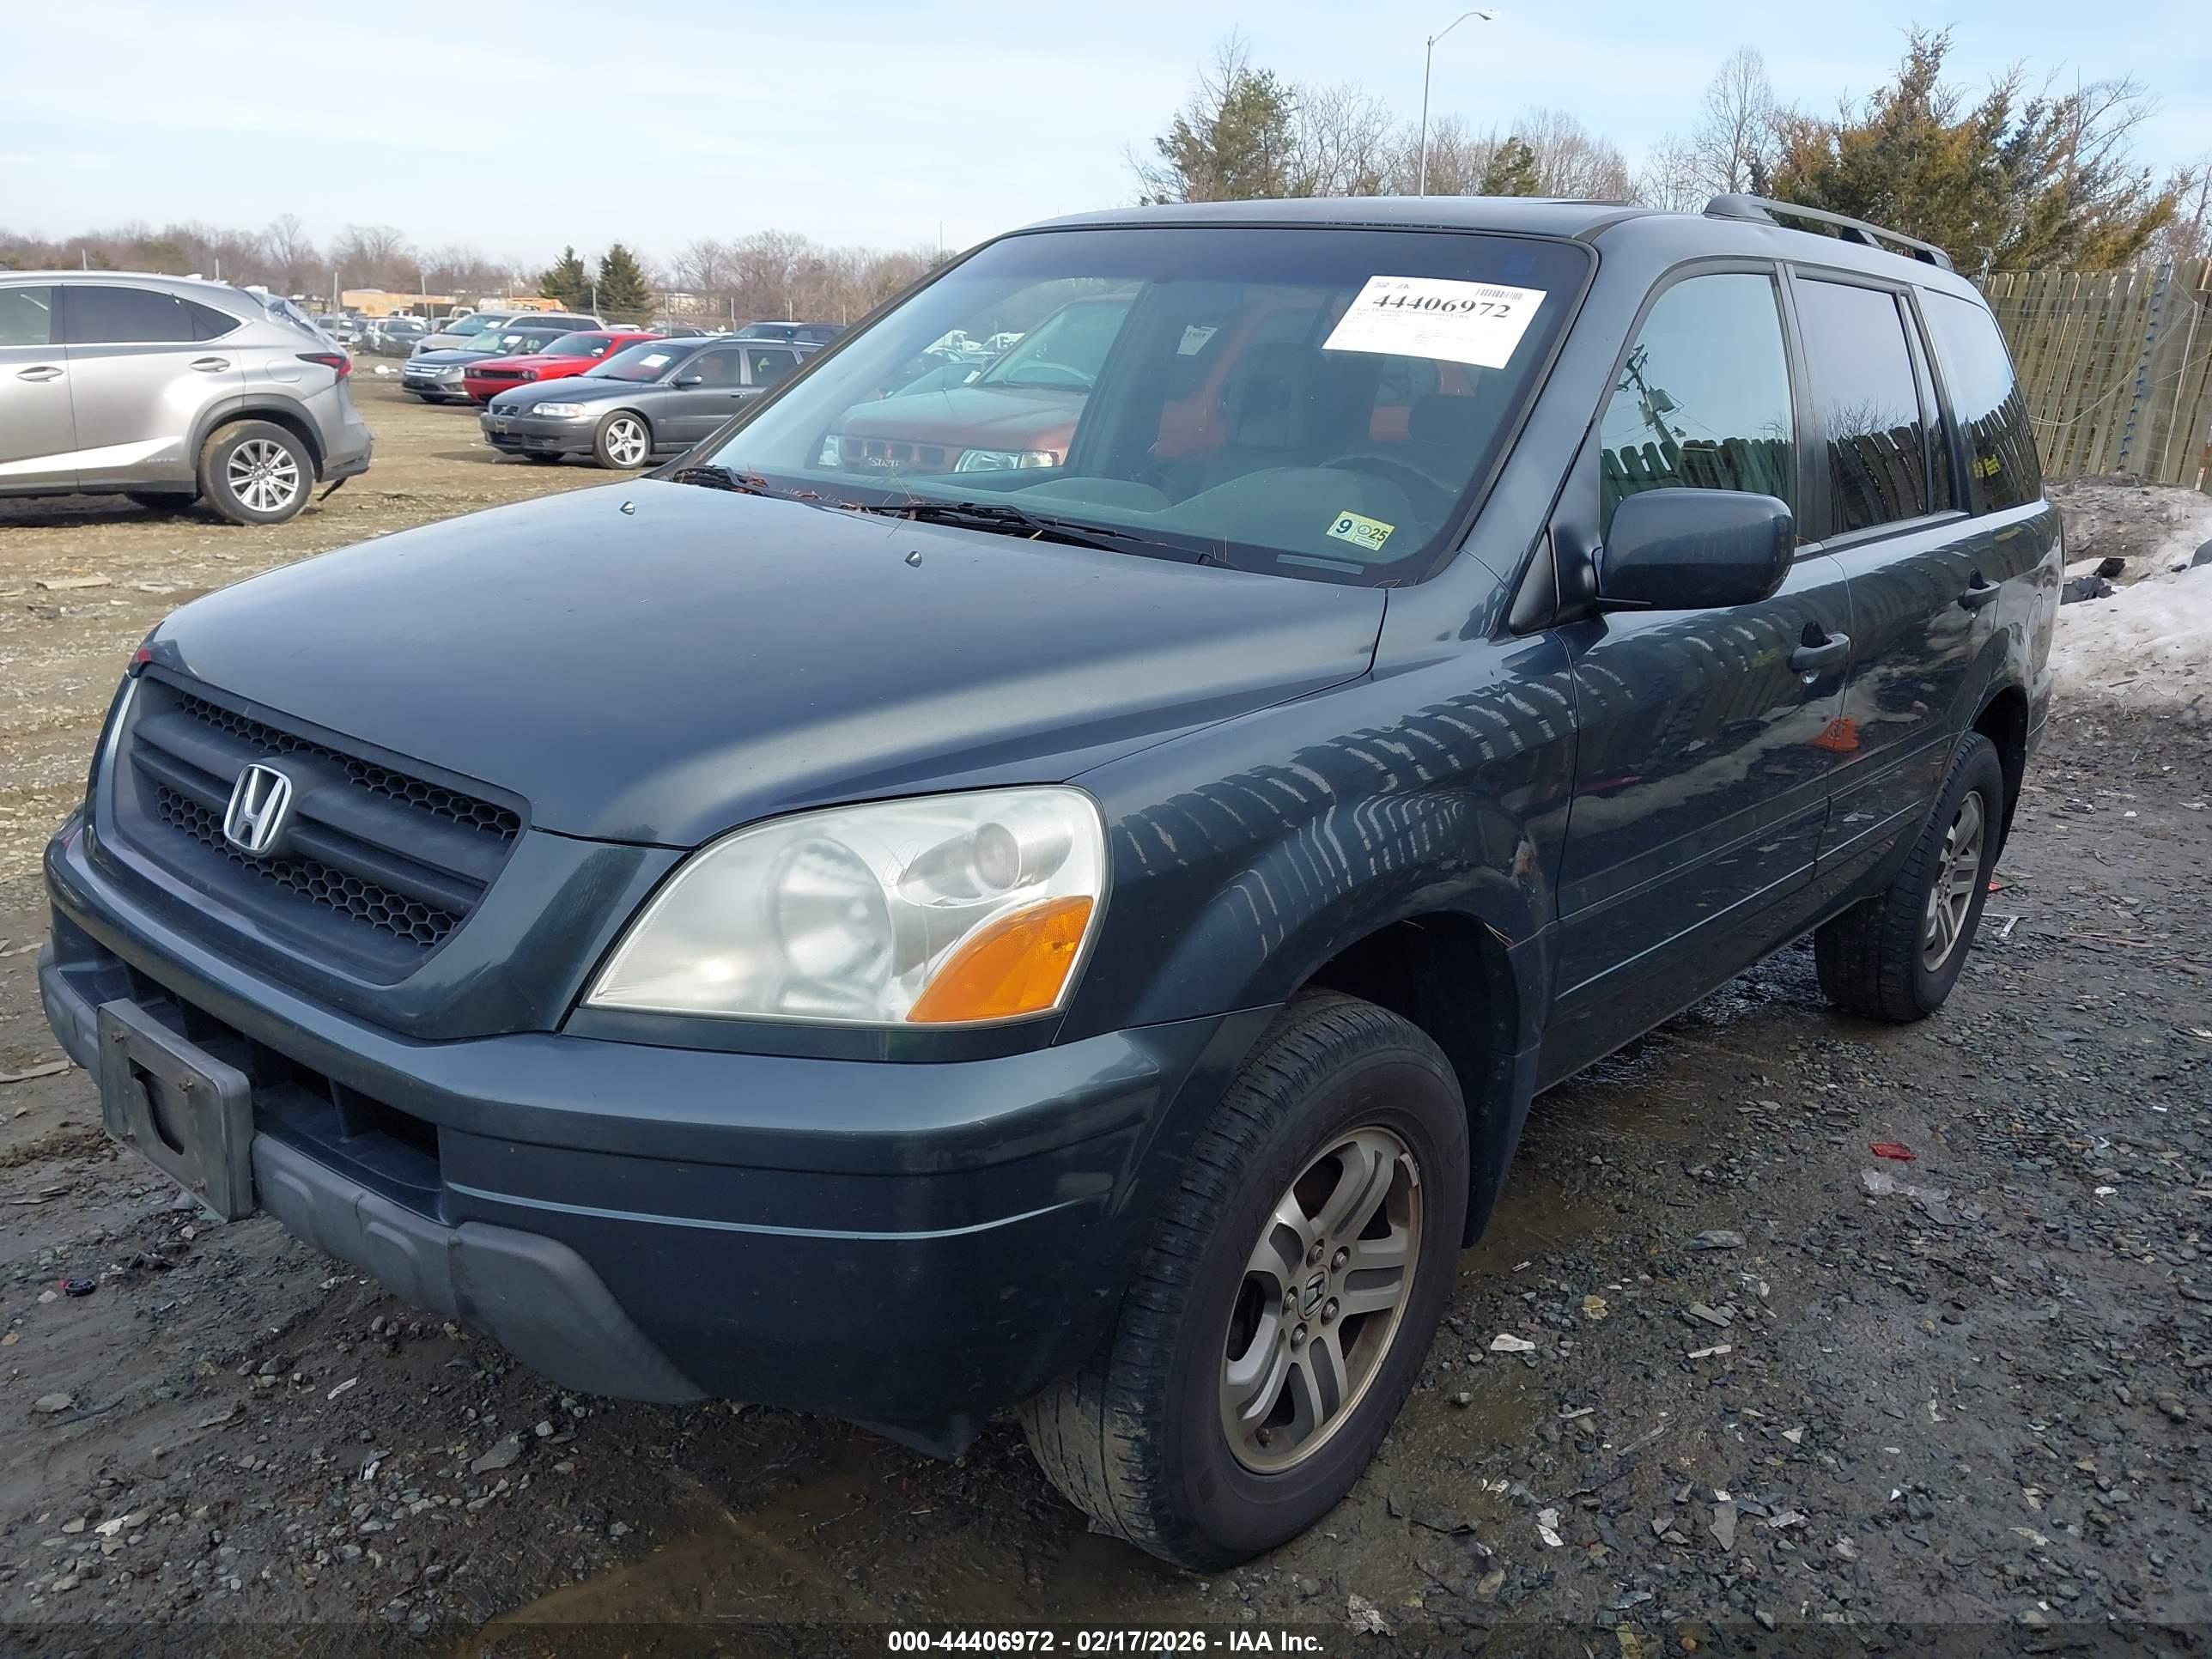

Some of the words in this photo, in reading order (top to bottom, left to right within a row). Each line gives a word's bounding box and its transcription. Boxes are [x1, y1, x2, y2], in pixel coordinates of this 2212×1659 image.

[1372, 294, 1511, 319] 44406972
[1335, 519, 1353, 534] 9
[1369, 527, 1389, 541] 25
